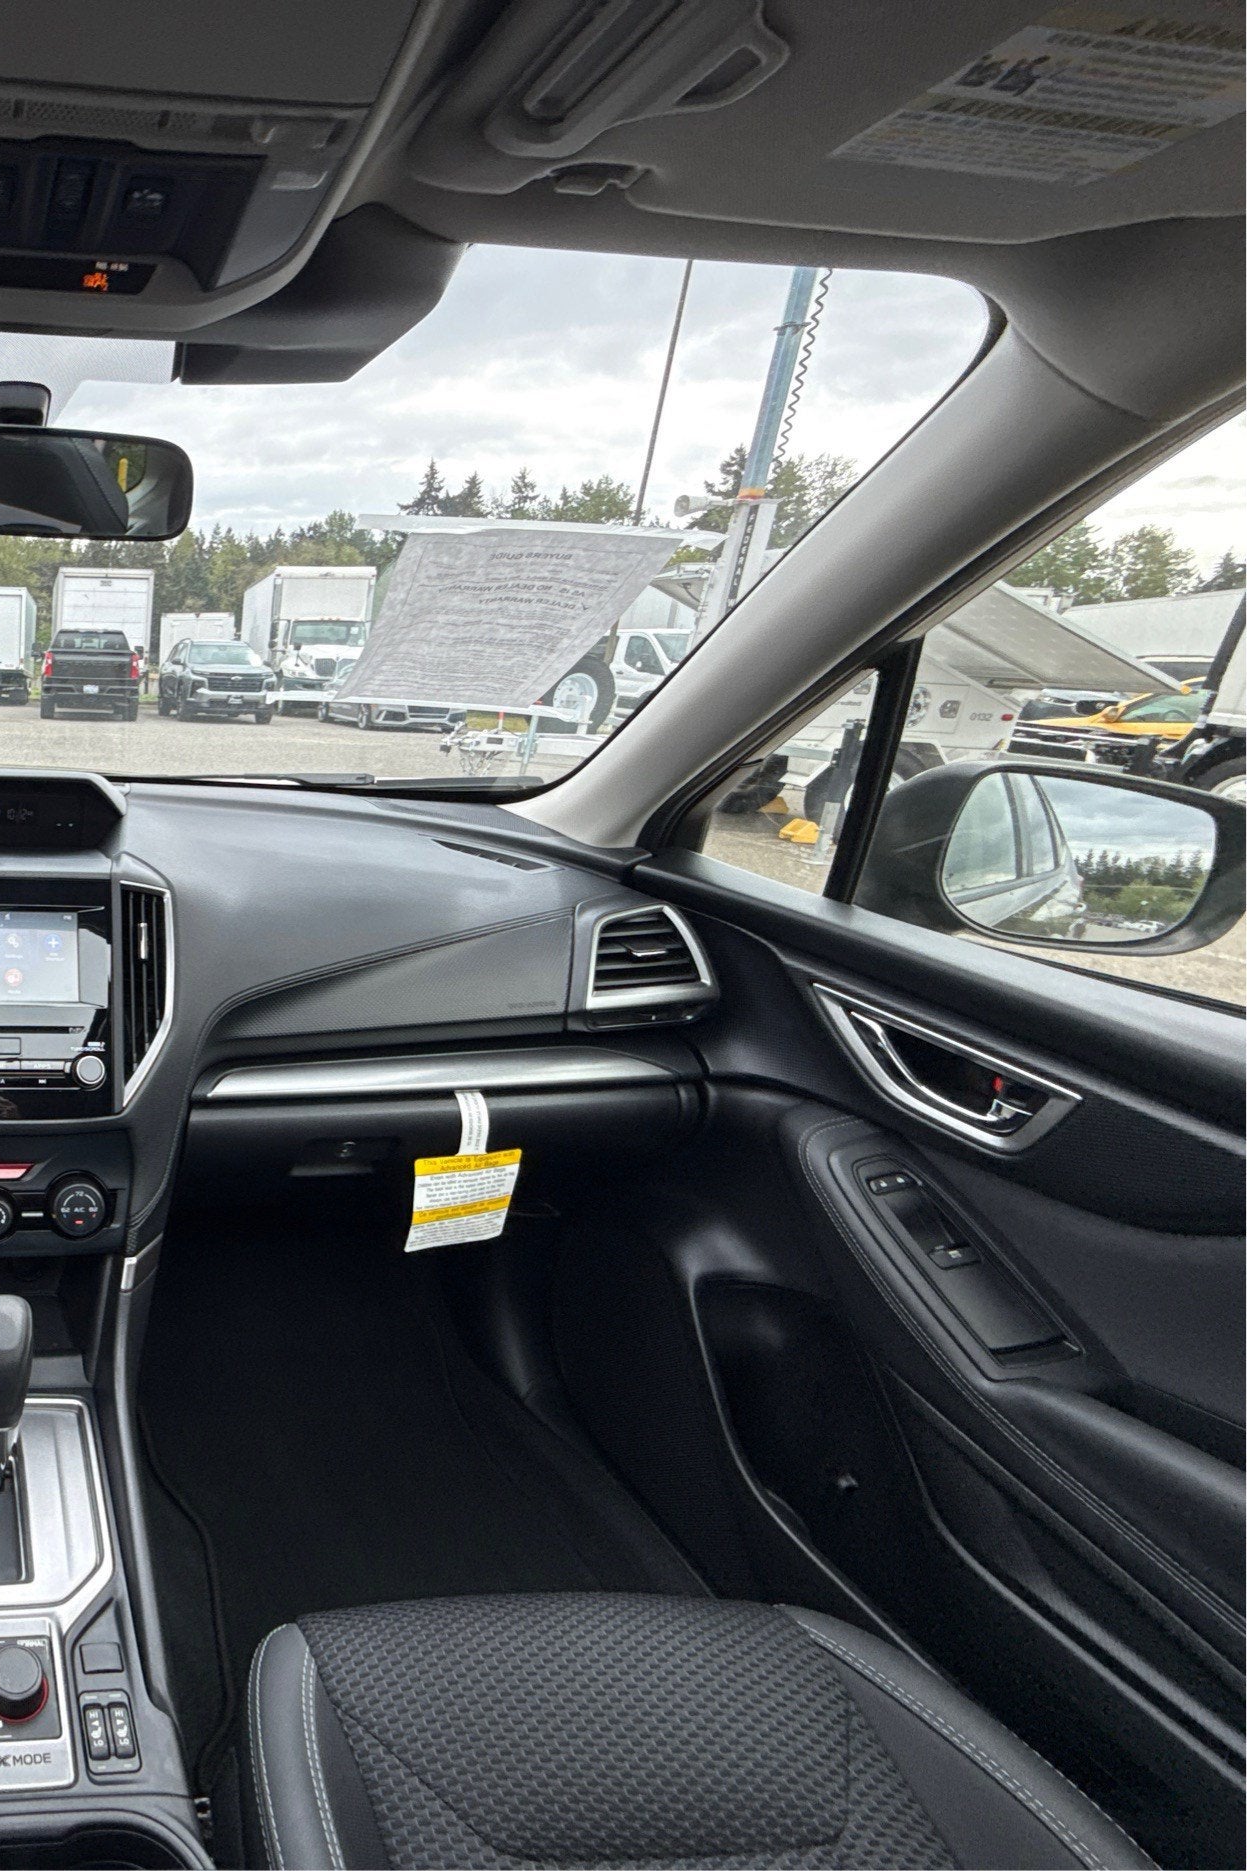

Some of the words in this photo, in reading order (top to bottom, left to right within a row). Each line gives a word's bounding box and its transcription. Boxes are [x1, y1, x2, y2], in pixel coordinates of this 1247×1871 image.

[732, 513, 756, 587] FEDERAL
[89, 1711, 99, 1719] HI
[114, 1709, 124, 1718] HI
[93, 1739, 104, 1747] LO
[119, 1738, 130, 1746] LO
[12, 1752, 52, 1766] MODE
